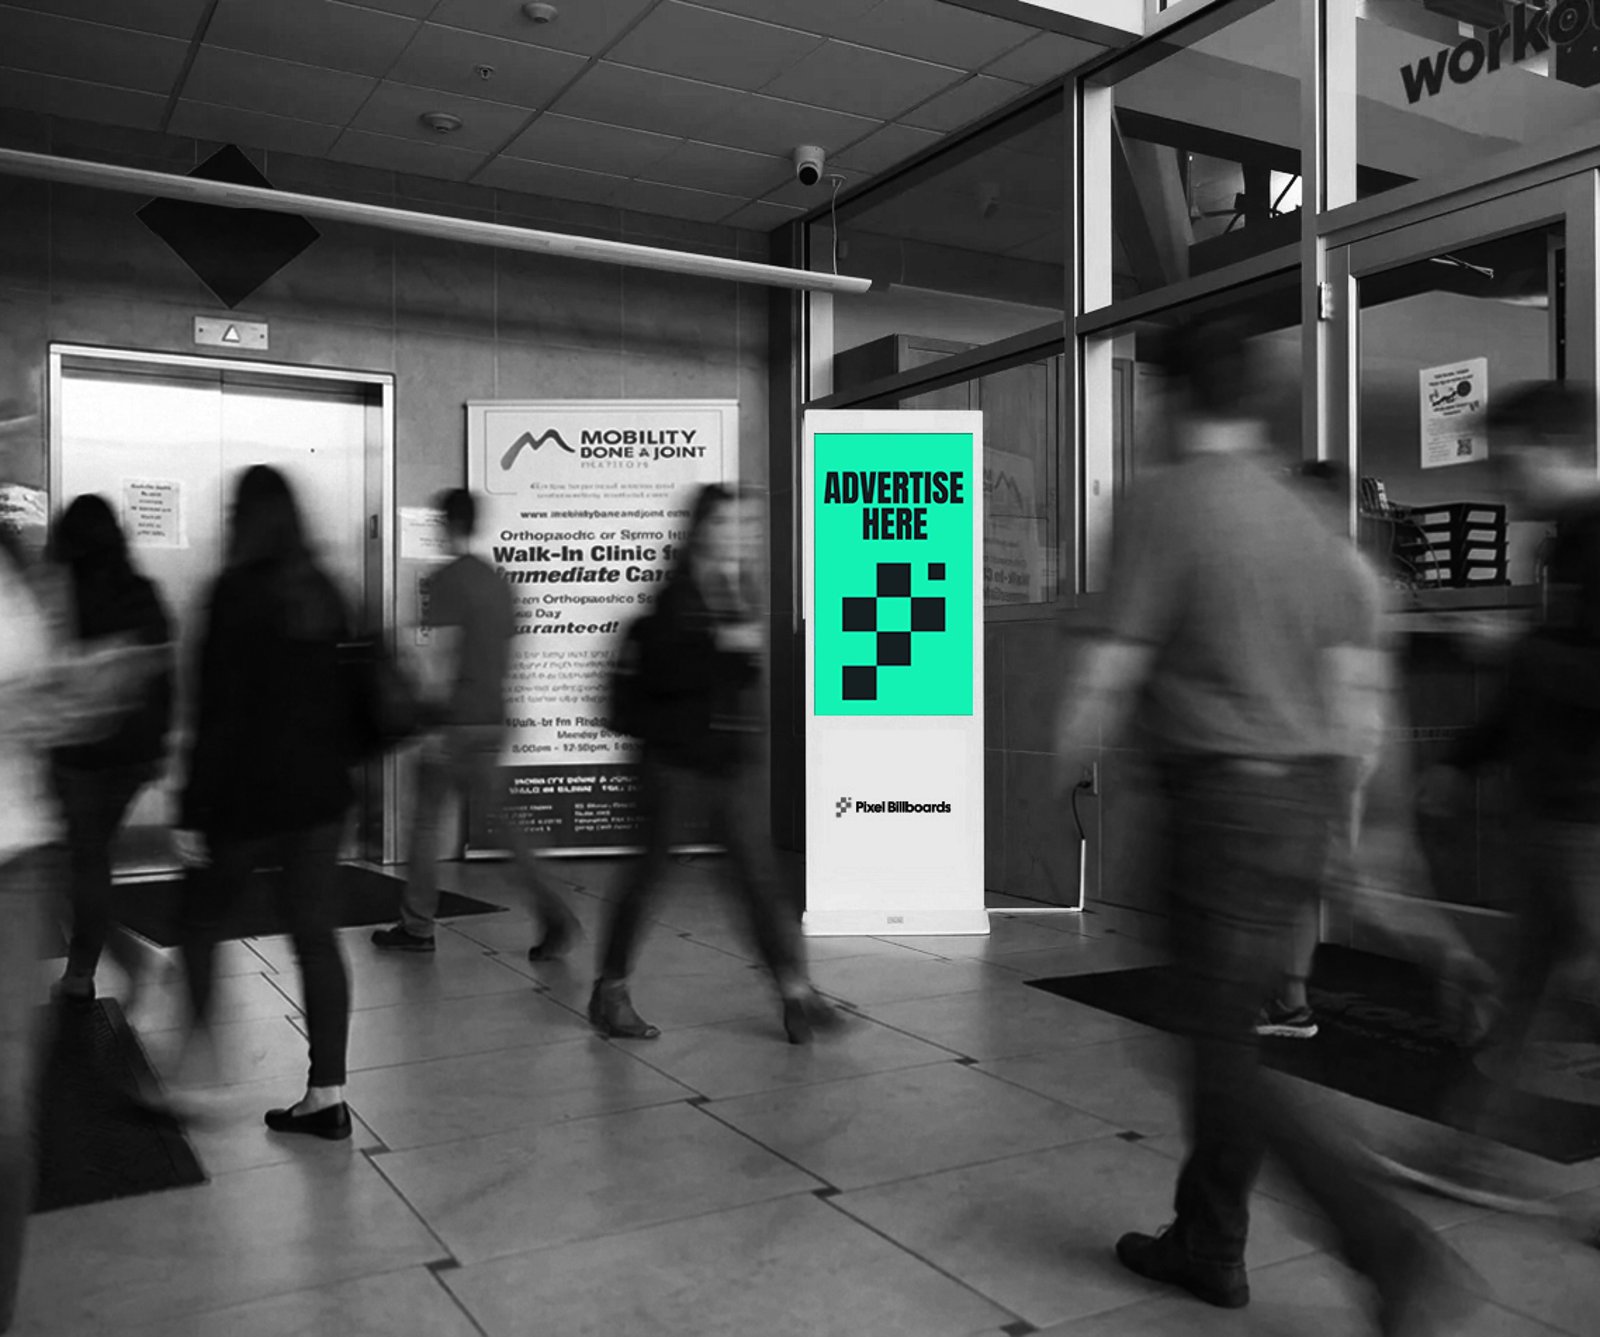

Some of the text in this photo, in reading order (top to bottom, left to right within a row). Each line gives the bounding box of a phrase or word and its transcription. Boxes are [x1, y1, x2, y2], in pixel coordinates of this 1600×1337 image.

[1400, 0, 1600, 104] worko
[580, 430, 697, 445] MOBILITY
[653, 446, 707, 461] JOINT
[823, 471, 964, 504] ADVERTISE
[862, 507, 928, 540] HERE
[492, 546, 583, 562] Walk-In
[590, 545, 657, 561] Clinic
[535, 608, 562, 619] Day
[855, 801, 951, 813] Pixel Billboards
